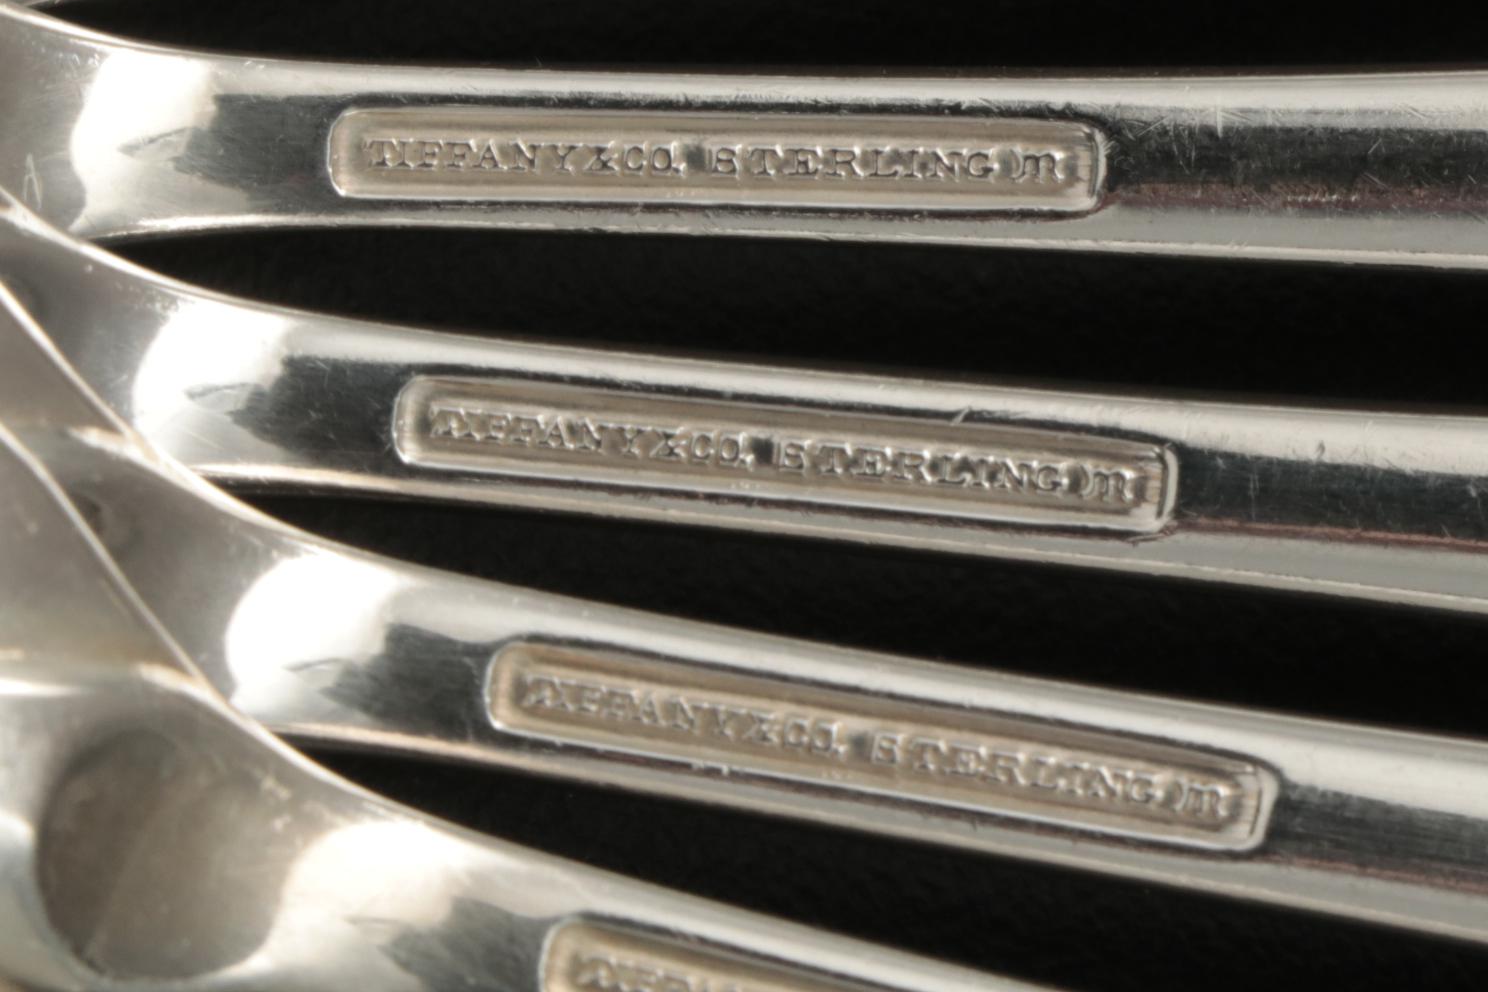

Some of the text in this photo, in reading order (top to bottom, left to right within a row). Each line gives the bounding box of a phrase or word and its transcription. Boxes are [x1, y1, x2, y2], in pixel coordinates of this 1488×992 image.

[710, 143, 998, 183] STERLING
[775, 435, 1068, 496] STERLING
[870, 731, 1165, 808] STERLING
